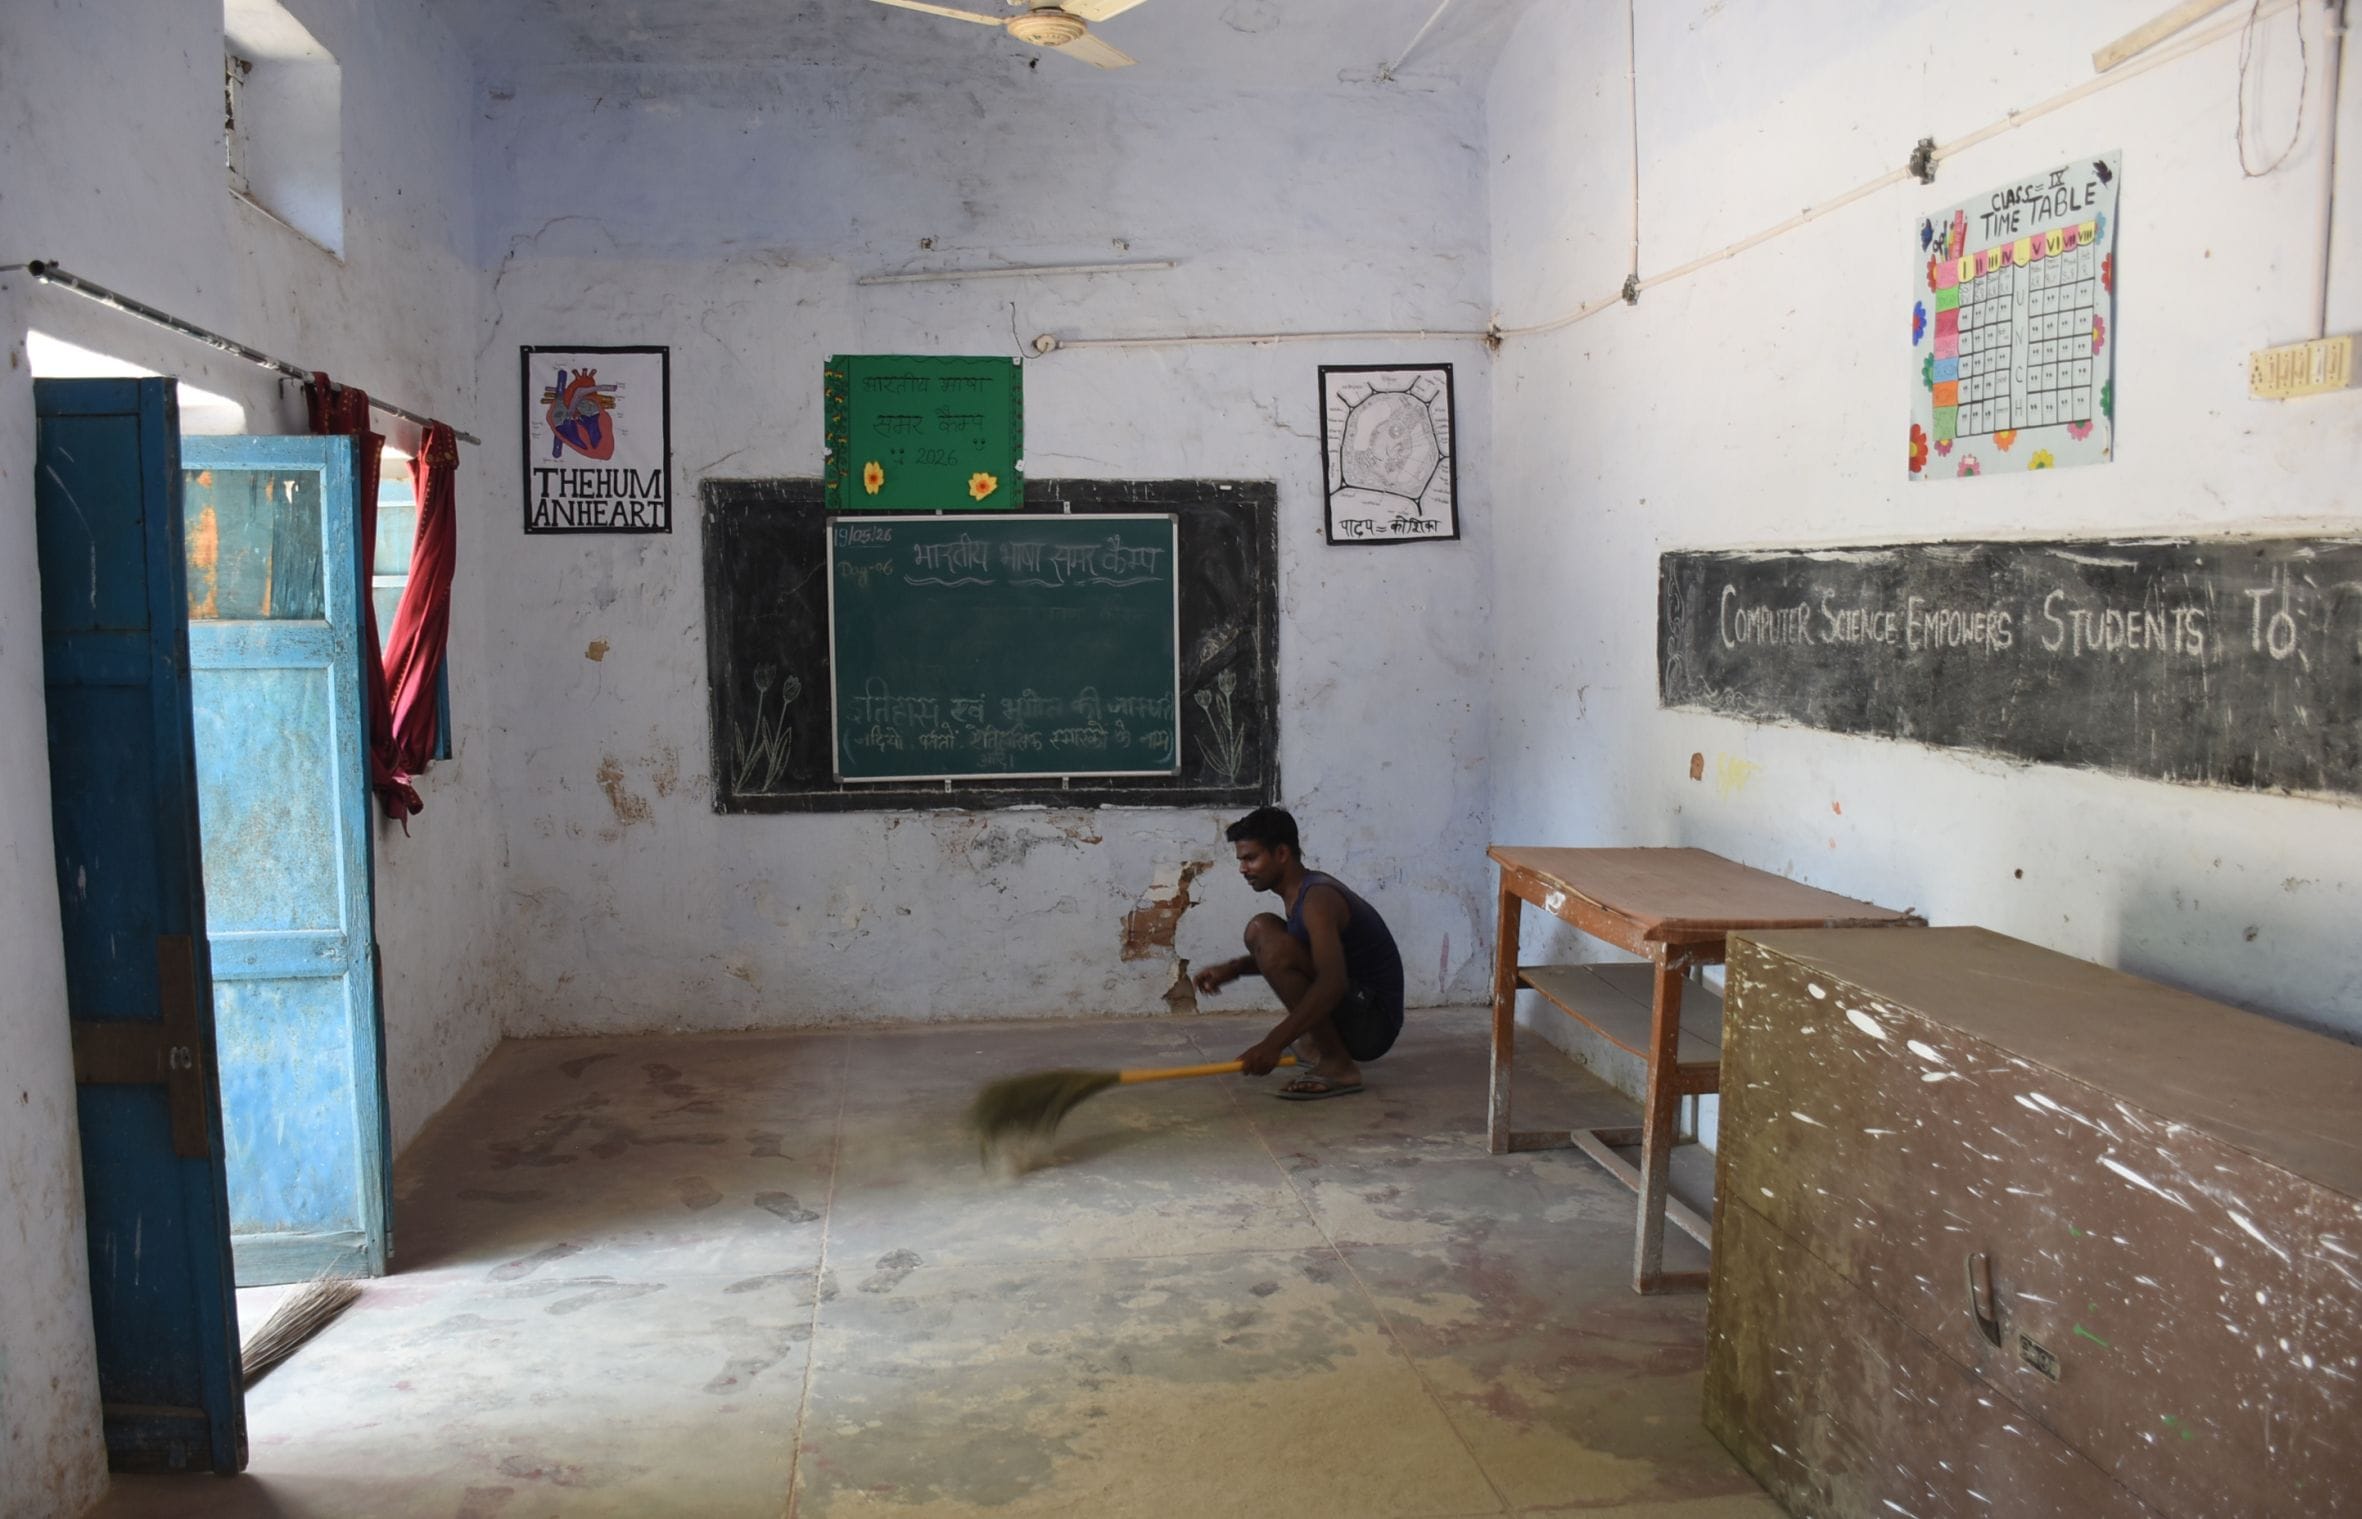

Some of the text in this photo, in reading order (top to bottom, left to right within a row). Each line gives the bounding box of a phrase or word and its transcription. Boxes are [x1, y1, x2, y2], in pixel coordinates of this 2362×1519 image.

[1979, 181, 2097, 241] TIME TABLE
[1992, 184, 2033, 212] CLASS
[1988, 254, 1998, 268] III
[2002, 251, 2013, 264] IV
[2032, 242, 2042, 255] V
[2046, 236, 2060, 250] VI
[2078, 230, 2093, 242] VIII
[939, 376, 993, 393] भाषा
[915, 447, 959, 467] 2026
[914, 533, 991, 574] भारतीय
[1000, 541, 1047, 572] भाषा
[1720, 584, 1815, 649] COMPUTER
[1820, 587, 1898, 645] SCIENCE
[1906, 596, 2013, 651] EMPOWERS
[2041, 588, 2206, 658] STUDENTS
